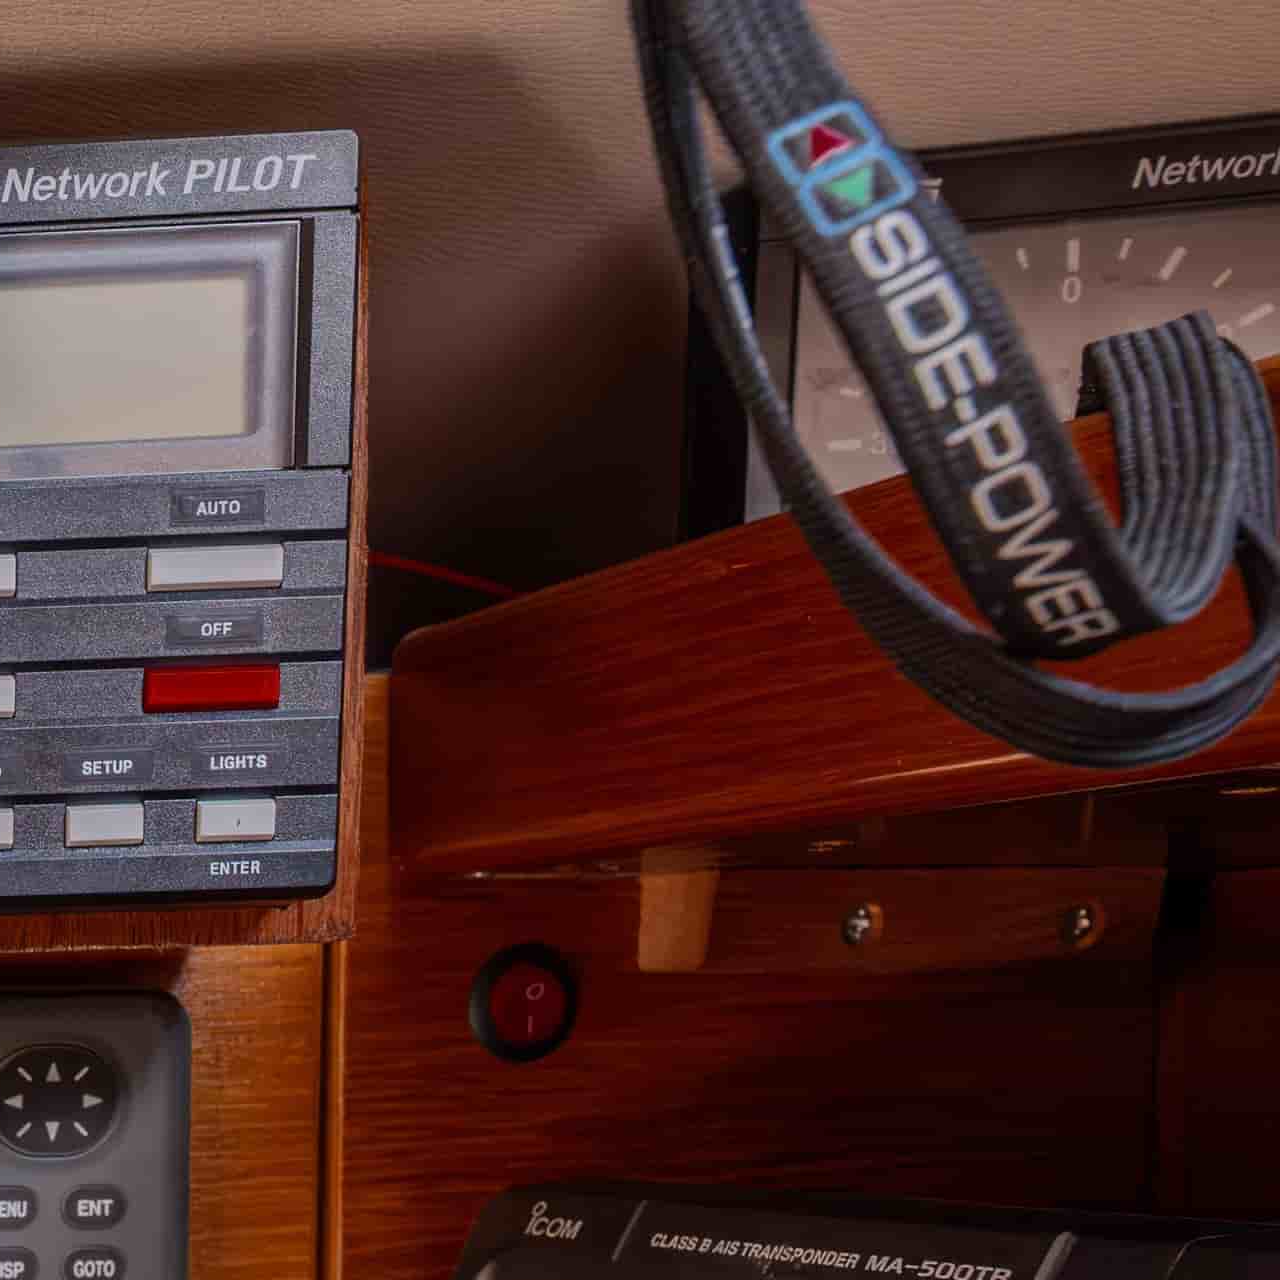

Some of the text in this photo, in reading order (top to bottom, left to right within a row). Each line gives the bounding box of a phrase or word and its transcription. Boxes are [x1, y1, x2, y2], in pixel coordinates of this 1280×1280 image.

[0, 164, 167, 203] Network
[183, 153, 319, 194] PILOT
[195, 499, 241, 517] AUTO
[199, 621, 234, 638] OFF
[81, 758, 134, 777] SETUP
[209, 753, 268, 772] LIGHTS
[209, 859, 261, 878] ENTER
[76, 1198, 114, 1217] ENT
[650, 1232, 697, 1252] CLASS
[698, 1238, 711, 1252] B
[712, 1239, 740, 1255] AIS
[742, 1241, 861, 1270] TRANSPONDER
[73, 1259, 116, 1279] GOTO
